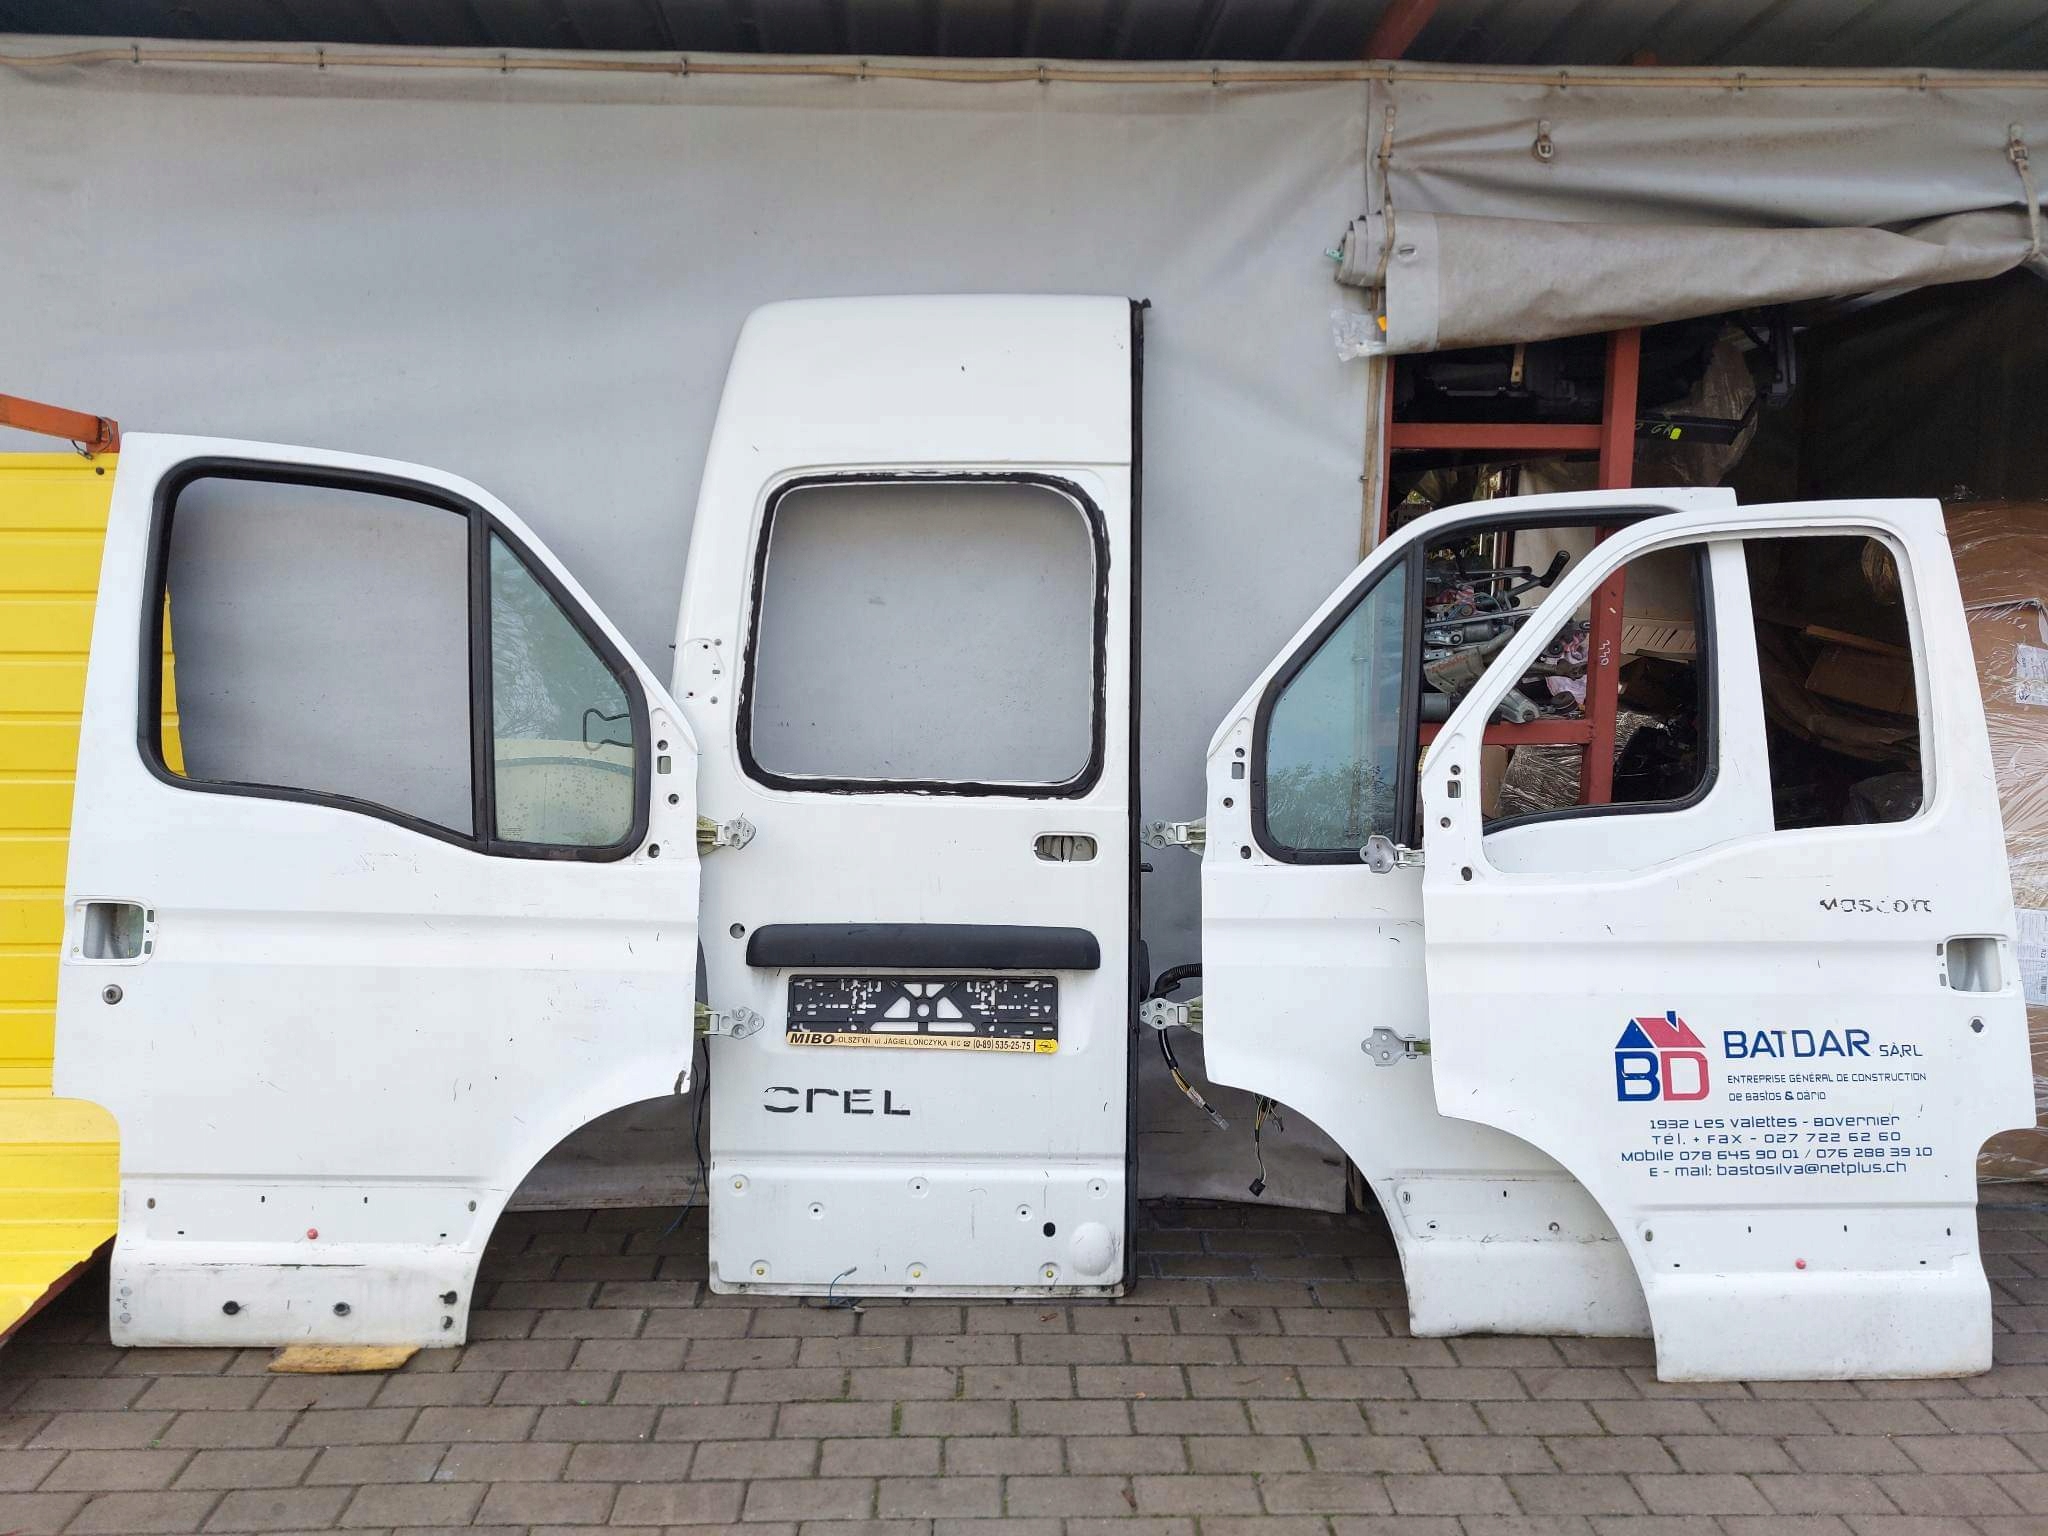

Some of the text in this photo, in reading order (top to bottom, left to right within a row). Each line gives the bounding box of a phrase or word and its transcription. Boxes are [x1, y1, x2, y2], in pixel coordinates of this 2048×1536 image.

[790, 1033, 835, 1044] MIBO
[995, 1040, 1031, 1050] 535-25-75
[1723, 1029, 1871, 1059] BATDAR
[1614, 1050, 1710, 1101] BD
[1727, 1074, 1787, 1084] ENTREPRISE
[1836, 1073, 1850, 1082] DE
[1851, 1072, 1927, 1082] CONSTRUCTION
[1784, 1090, 1795, 1101] &
[1649, 1119, 1690, 1130] 1932
[1694, 1118, 1726, 1129] Les
[1813, 1115, 1901, 1127] Bovernier
[1707, 1134, 1743, 1145] Fax
[1764, 1133, 1799, 1144] 027
[1806, 1132, 1842, 1143] 722
[1848, 1132, 1872, 1142] 62
[1878, 1131, 1902, 1142] 60
[1621, 1149, 1674, 1162] Mobile
[1679, 1150, 1713, 1161] 078
[1717, 1149, 1751, 1160] 645
[1755, 1149, 1777, 1160] 90
[1782, 1149, 1800, 1159] 01
[1816, 1148, 1848, 1159] 076
[1853, 1147, 1885, 1158] 288
[1889, 1147, 1911, 1157] 39
[1915, 1146, 1933, 1157] 10
[1649, 1167, 1659, 1177] E
[1675, 1164, 1712, 1177] mail:
[1716, 1160, 1907, 1176] bastosilva@netplus.ch
